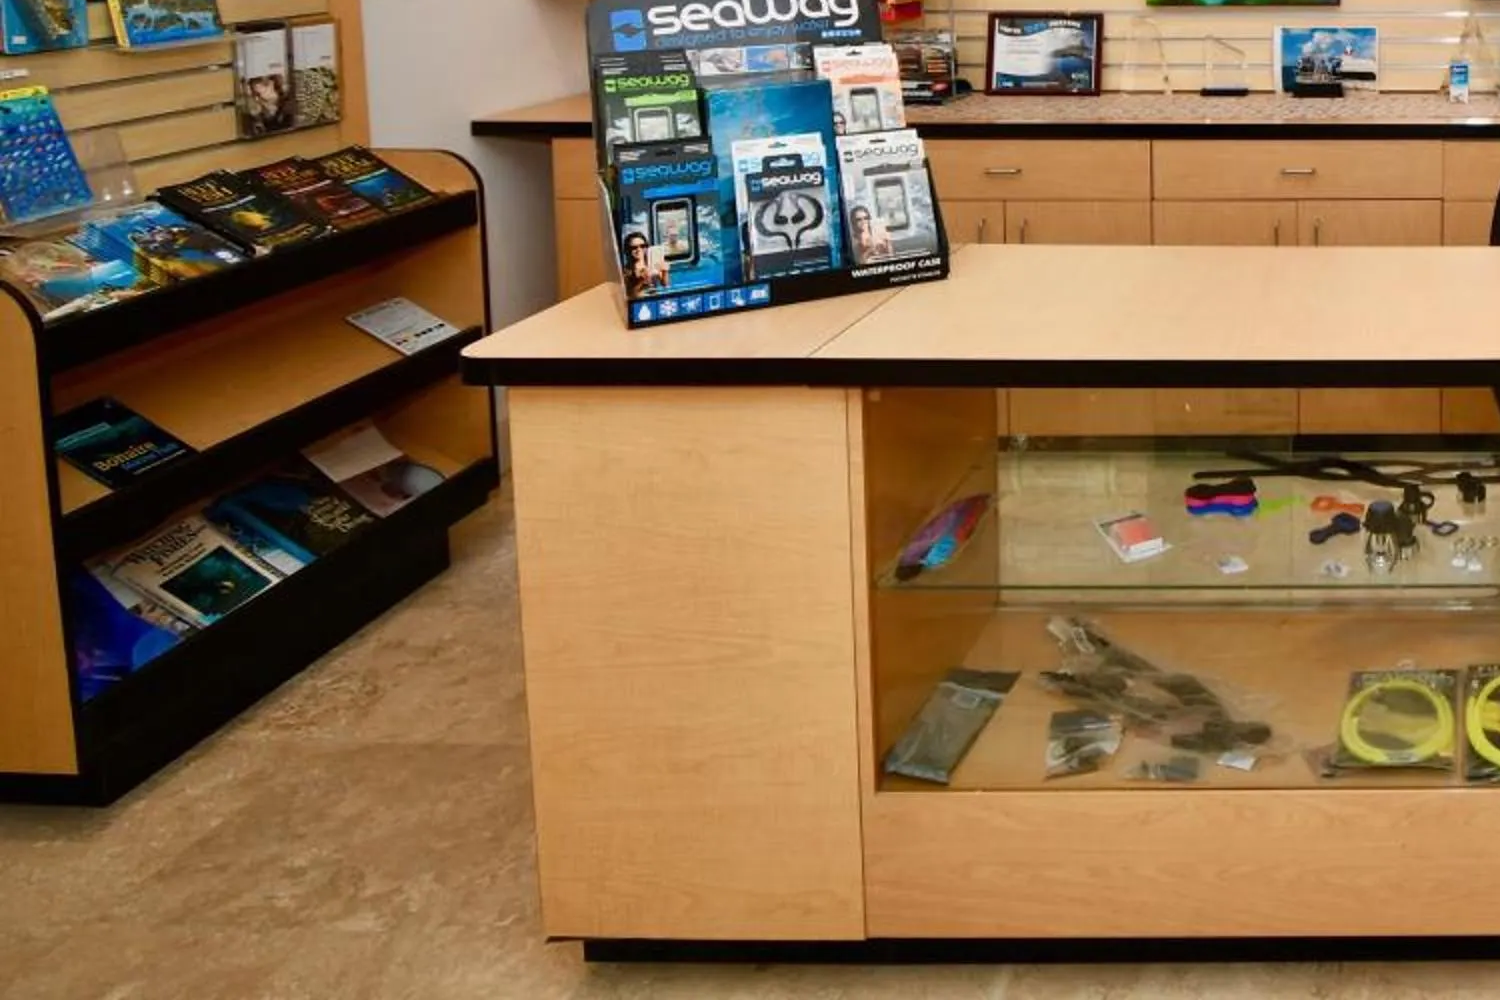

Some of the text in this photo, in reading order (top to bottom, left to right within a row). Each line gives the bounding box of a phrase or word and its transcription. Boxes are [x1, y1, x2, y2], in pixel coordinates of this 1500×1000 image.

[617, 74, 690, 90] seawag
[854, 144, 918, 160] seawag
[634, 160, 713, 179] seawag
[761, 172, 822, 188] seawag
